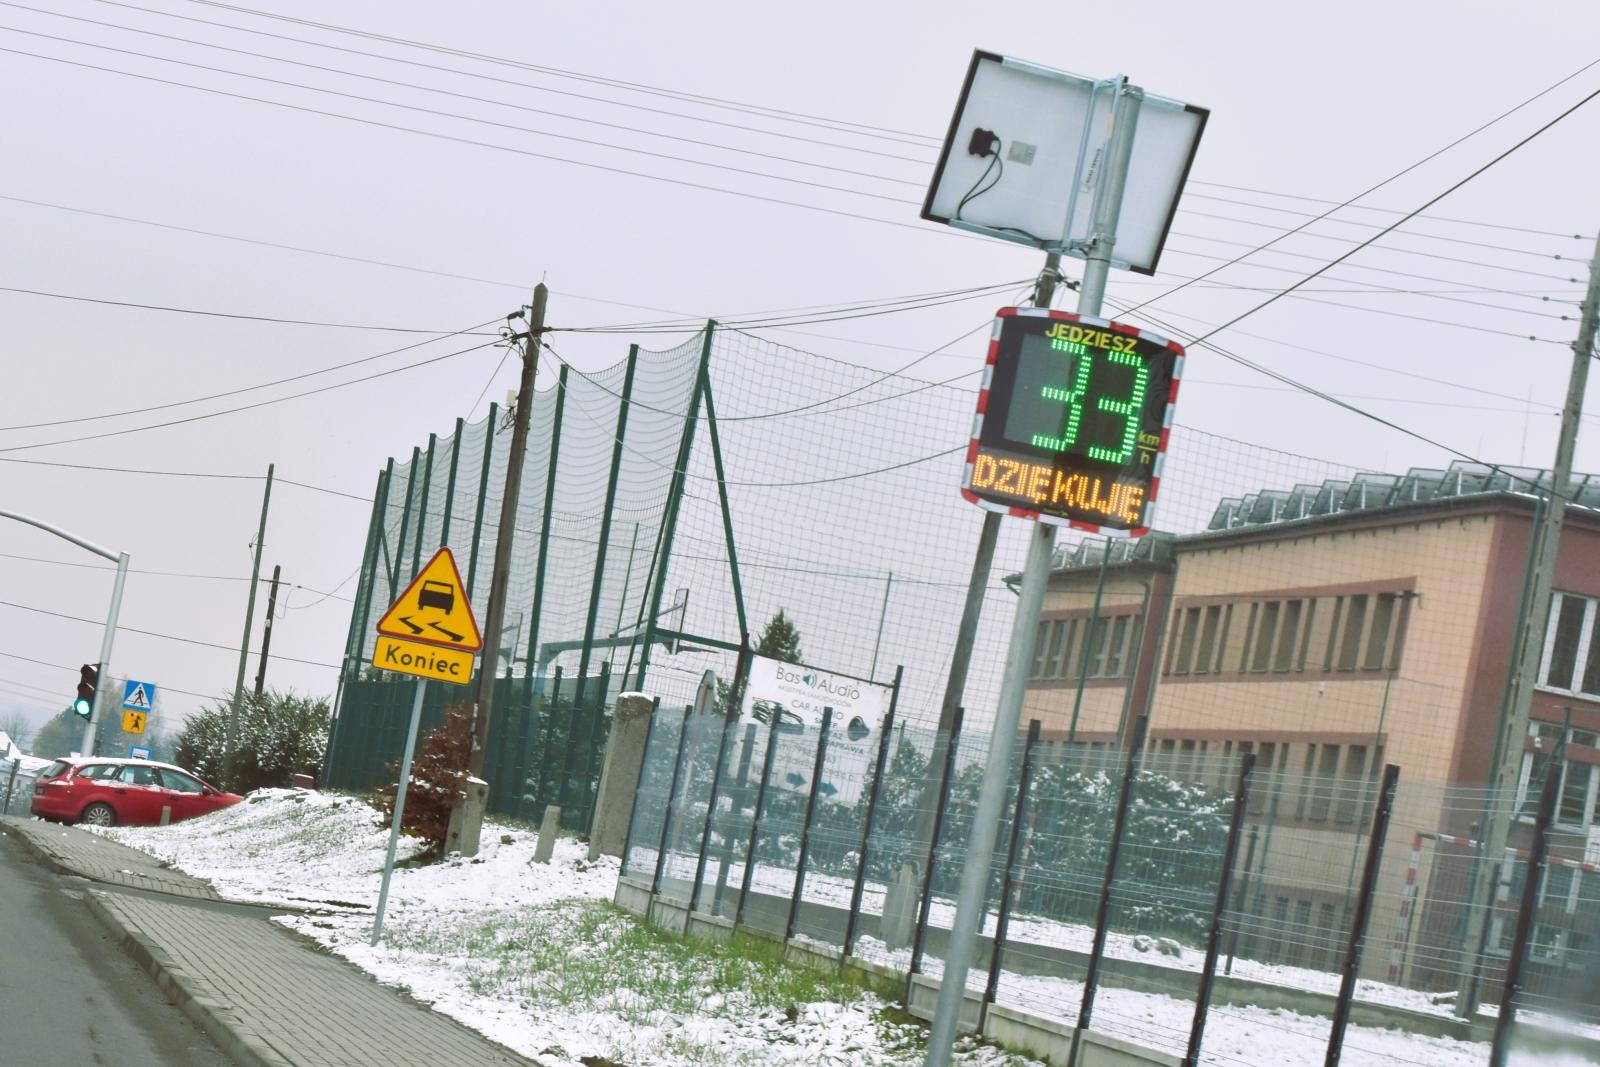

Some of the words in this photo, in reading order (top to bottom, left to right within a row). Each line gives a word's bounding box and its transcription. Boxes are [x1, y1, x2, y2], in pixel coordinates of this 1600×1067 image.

[1045, 323, 1138, 354] JEDZIESZ
[1032, 338, 1149, 463] 33
[1138, 430, 1160, 447] km
[1140, 450, 1150, 464] h
[972, 454, 1144, 524] DZIĘKUJĘ
[385, 644, 461, 675] Koniec
[776, 666, 801, 685] Bas
[817, 679, 861, 701] Audio
[791, 699, 810, 711] CAR
[813, 705, 844, 720] AUIO
